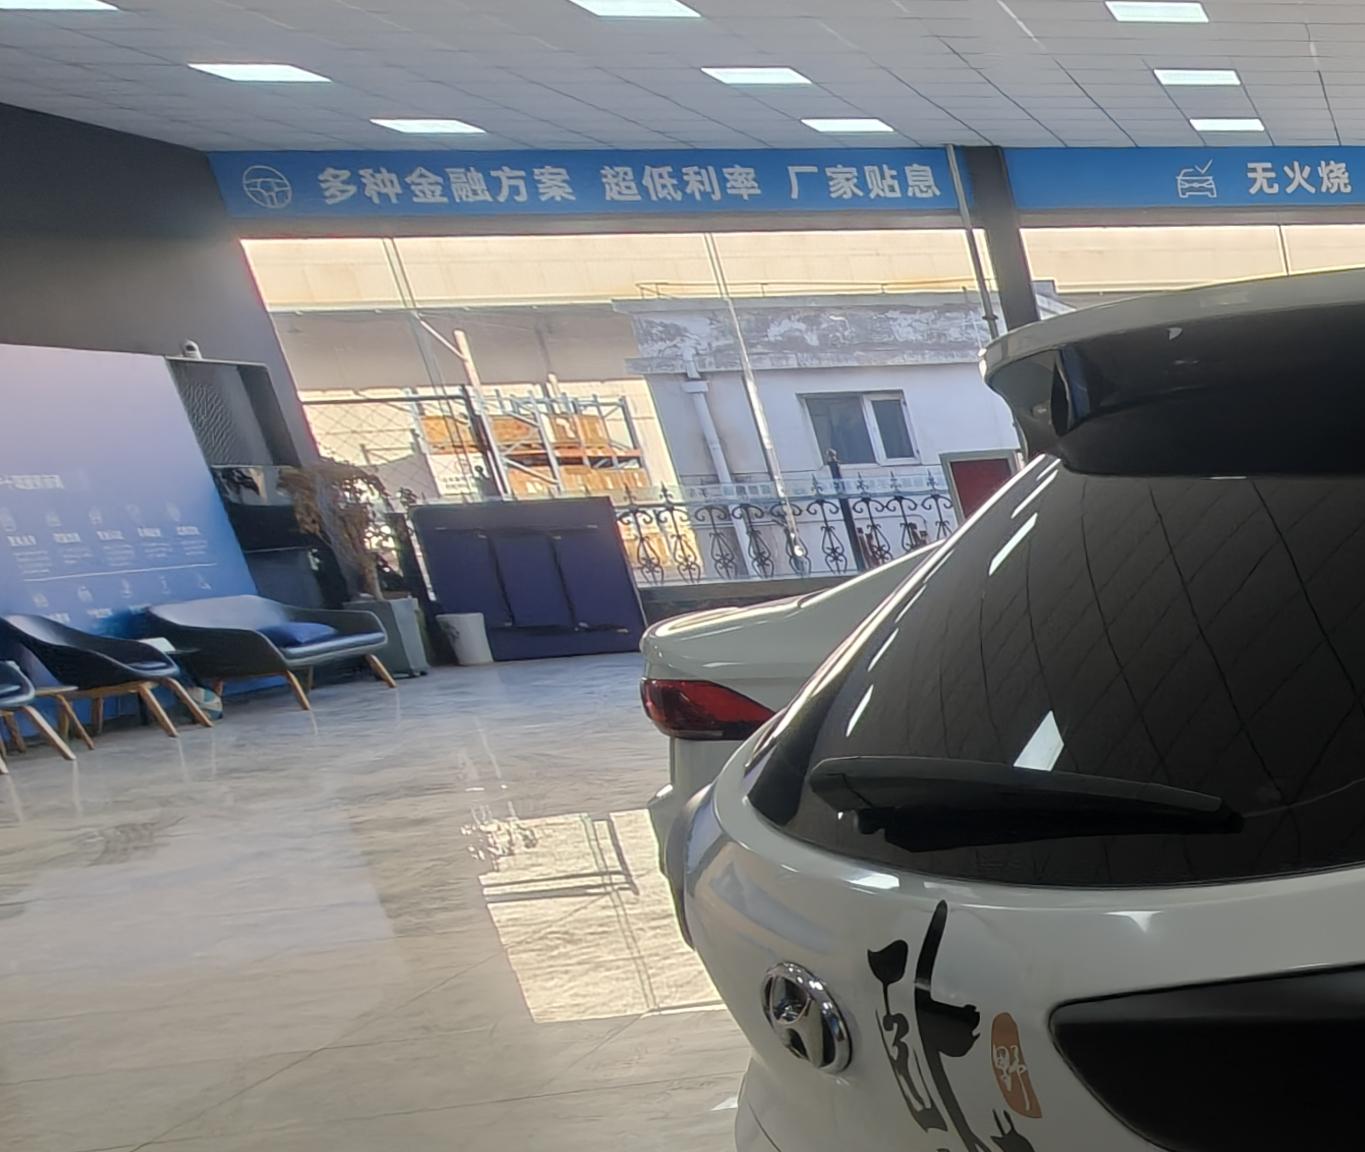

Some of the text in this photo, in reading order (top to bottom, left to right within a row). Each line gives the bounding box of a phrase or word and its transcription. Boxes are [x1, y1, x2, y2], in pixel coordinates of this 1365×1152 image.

[317, 164, 942, 206] 多种金融方案 超低利率 厂家贴息
[1246, 160, 1352, 194] 无火烧
